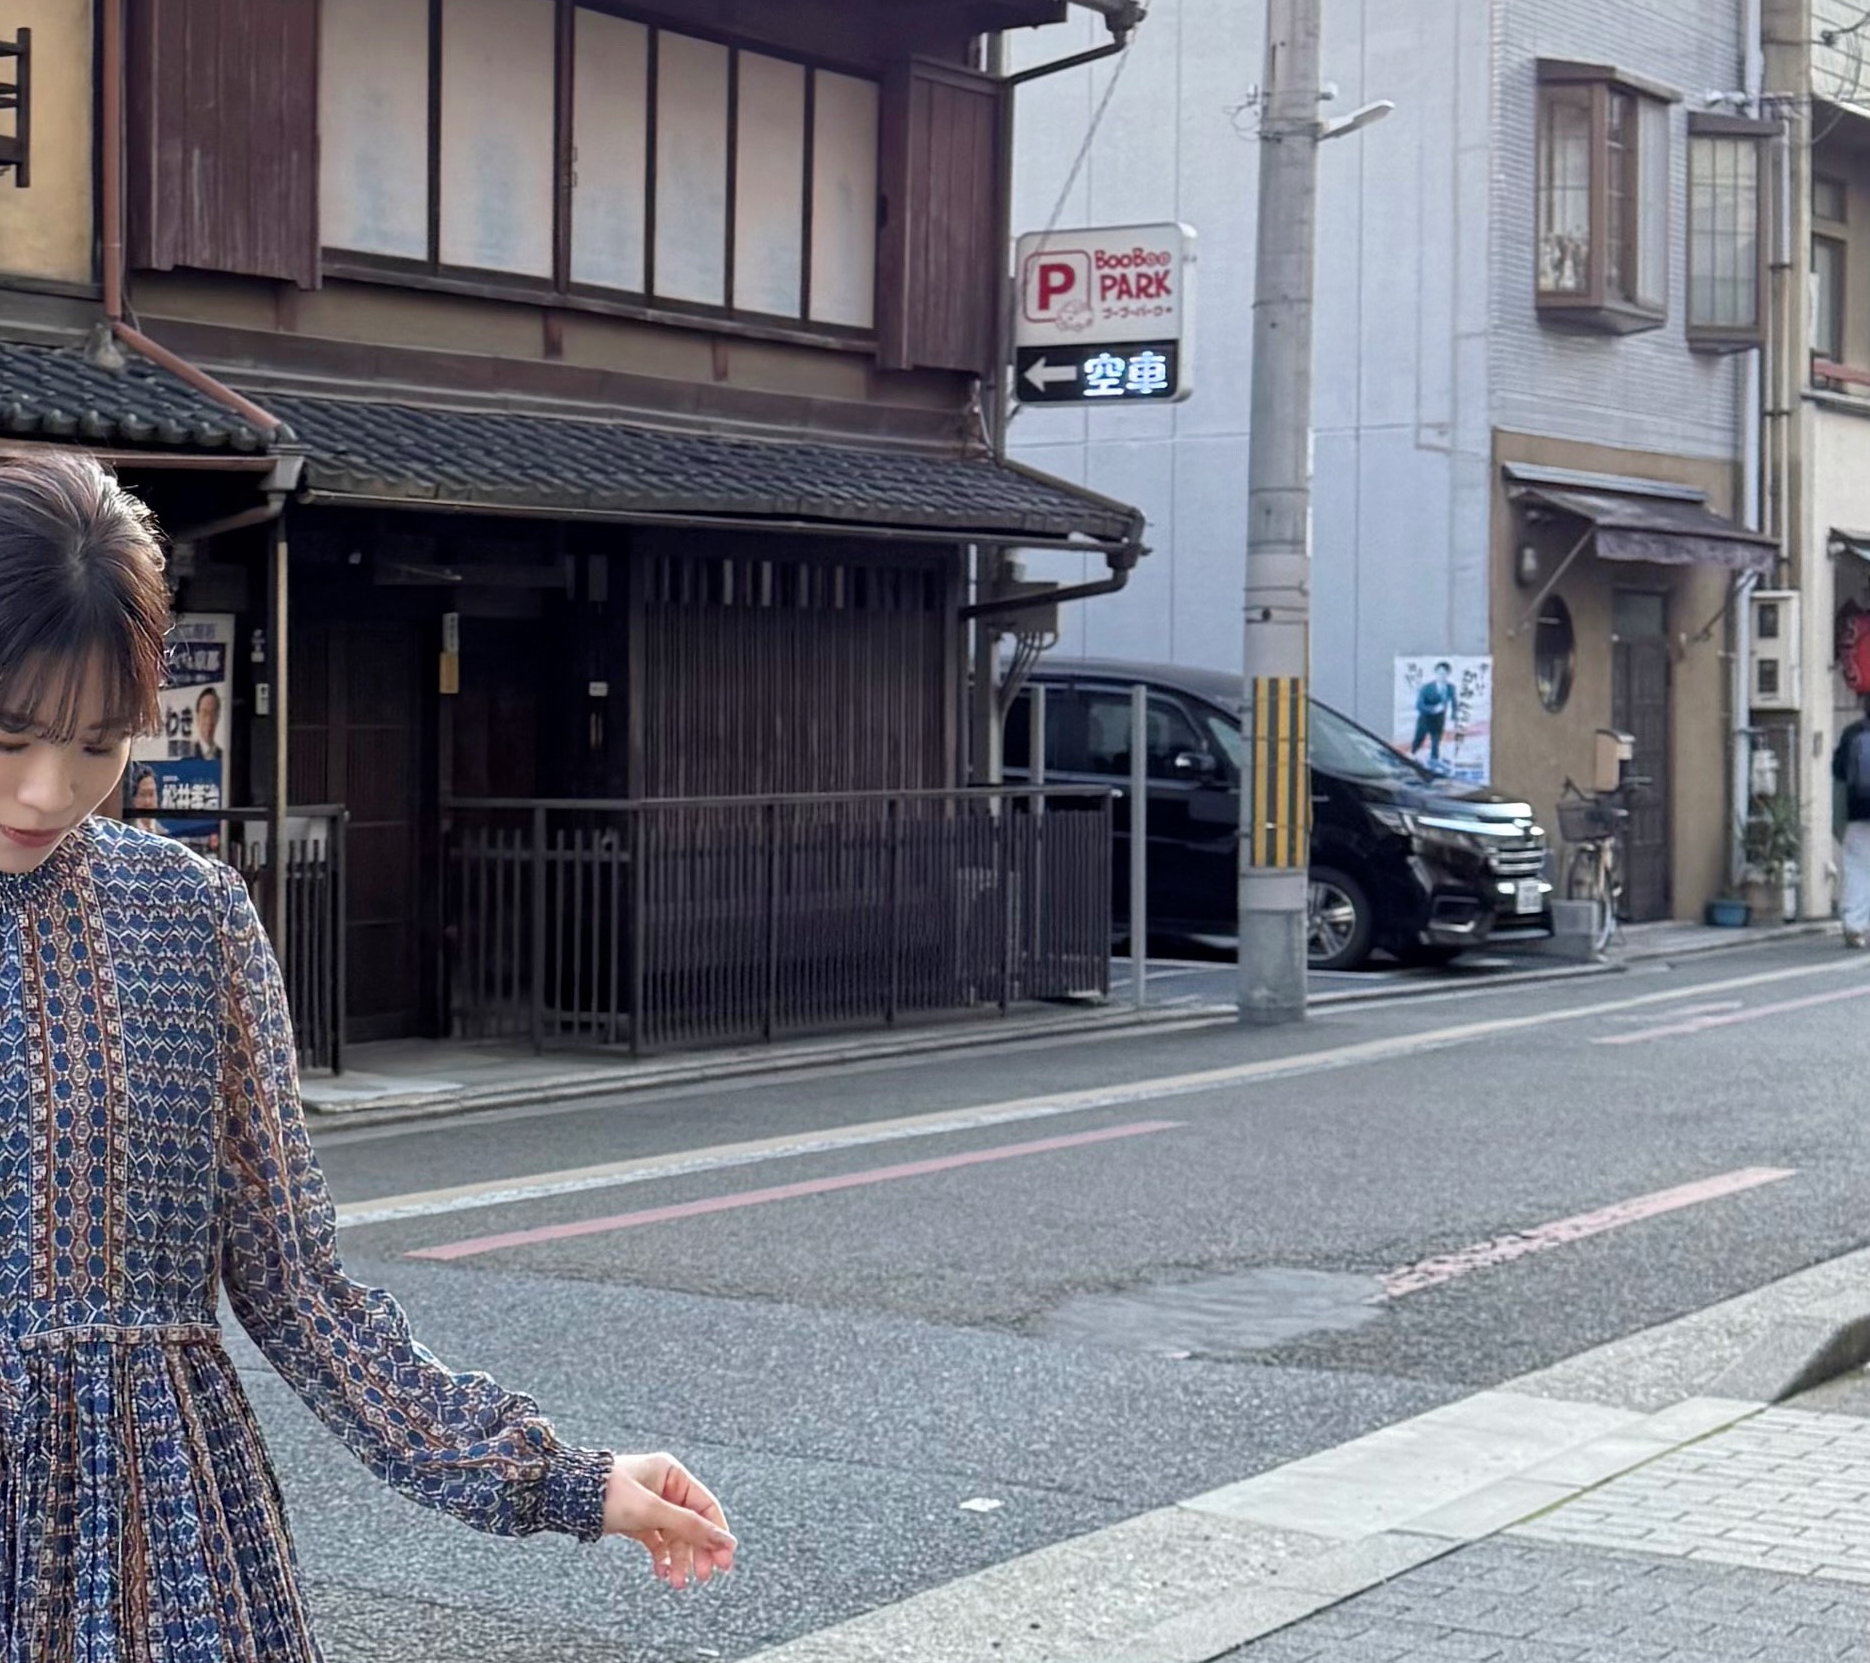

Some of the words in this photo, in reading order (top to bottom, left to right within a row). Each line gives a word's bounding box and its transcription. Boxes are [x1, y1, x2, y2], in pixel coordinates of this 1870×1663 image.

[1094, 246, 1172, 270] BooBoo
[1037, 263, 1076, 311] P
[1100, 269, 1173, 302] PARK
[1082, 350, 1169, 397] 空車
